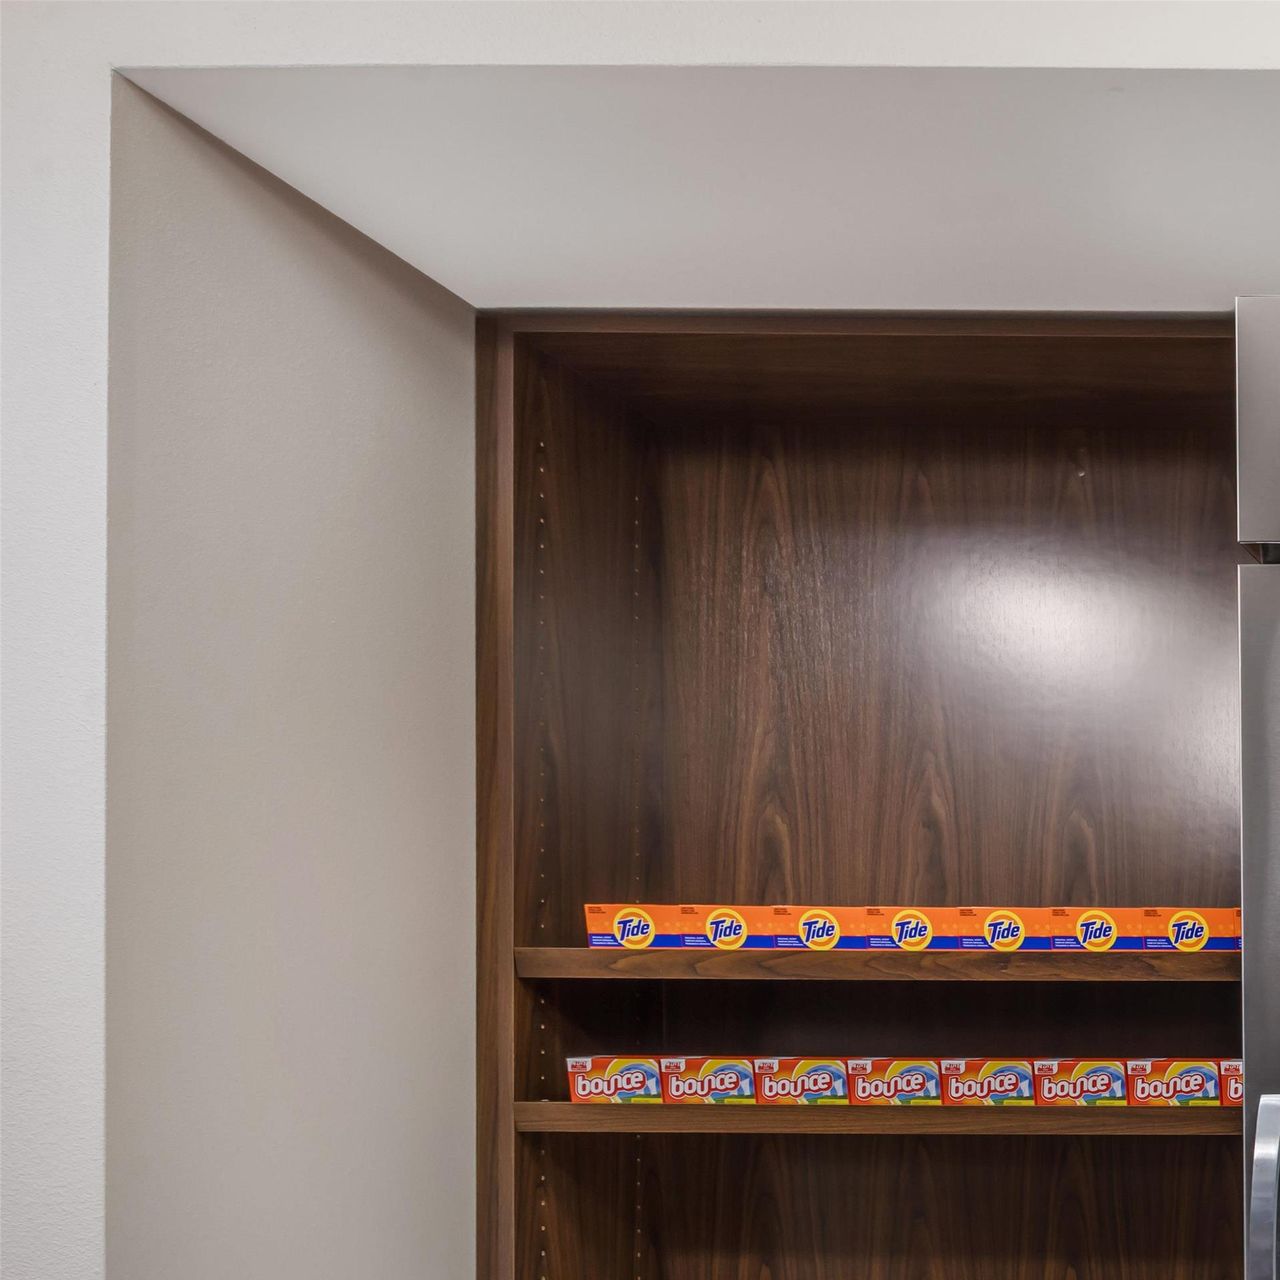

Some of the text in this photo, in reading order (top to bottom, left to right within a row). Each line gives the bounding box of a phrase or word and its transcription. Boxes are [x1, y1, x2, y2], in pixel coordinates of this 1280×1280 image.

[617, 917, 650, 941] Tide
[709, 918, 743, 942] Tide
[802, 918, 836, 942] Tide
[894, 919, 928, 943] Tide
[987, 919, 1020, 943] Tide
[1079, 919, 1113, 943] Tide
[1171, 920, 1205, 944] Tide
[576, 1072, 647, 1099] bounce
[670, 1072, 740, 1099] bounce
[764, 1072, 834, 1099] bounce
[857, 1072, 925, 1099] bounce
[949, 1073, 1019, 1100] bounce
[1042, 1073, 1112, 1100] bounce
[1134, 1073, 1205, 1100] bounce
